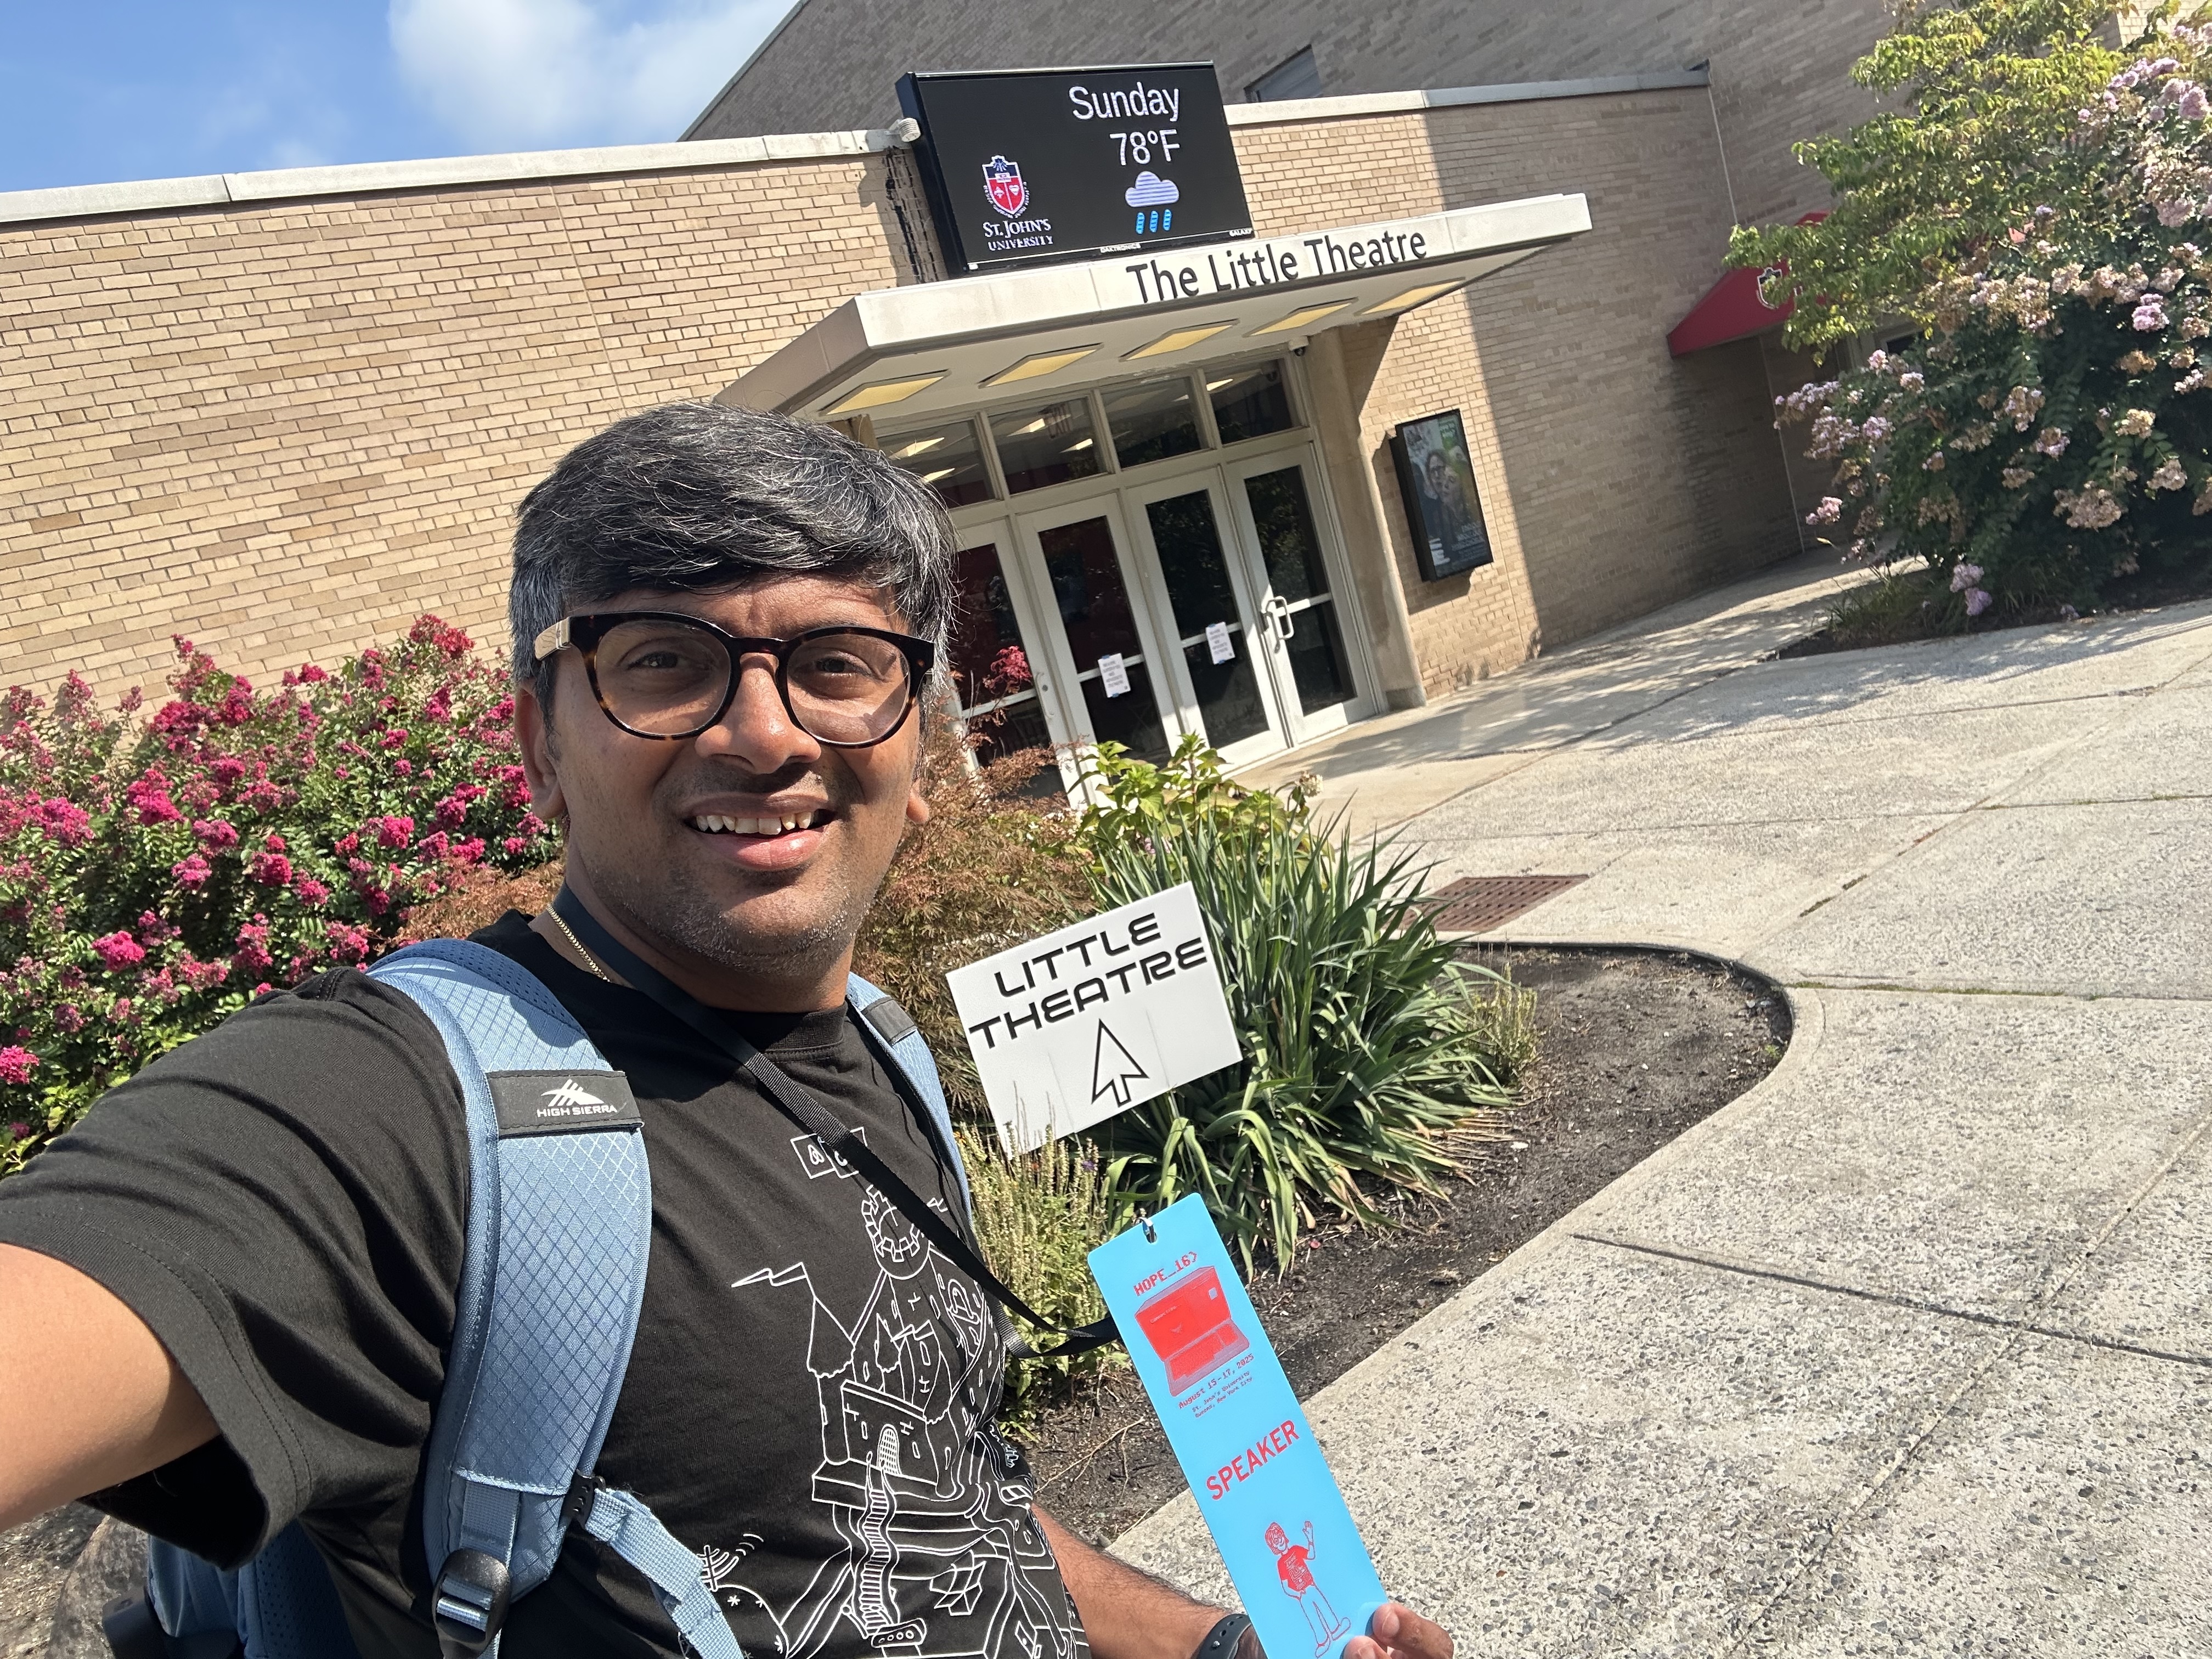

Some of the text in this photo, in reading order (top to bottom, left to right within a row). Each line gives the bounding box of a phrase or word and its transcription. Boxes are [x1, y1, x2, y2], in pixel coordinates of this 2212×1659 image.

[1069, 81, 1179, 122] Sunday
[1109, 129, 1180, 166] 78°F
[988, 235, 1053, 251] UNIVERSITY
[1126, 231, 1427, 303] The Little Theatre
[994, 912, 1161, 998] LITTLE
[968, 937, 1208, 1049] THEATRE
[537, 1104, 618, 1118] HIGH SIERRA
[1178, 1388, 1205, 1409] August
[1236, 1353, 1254, 1369] 2025
[1206, 1420, 1300, 1500] SPEAKER
